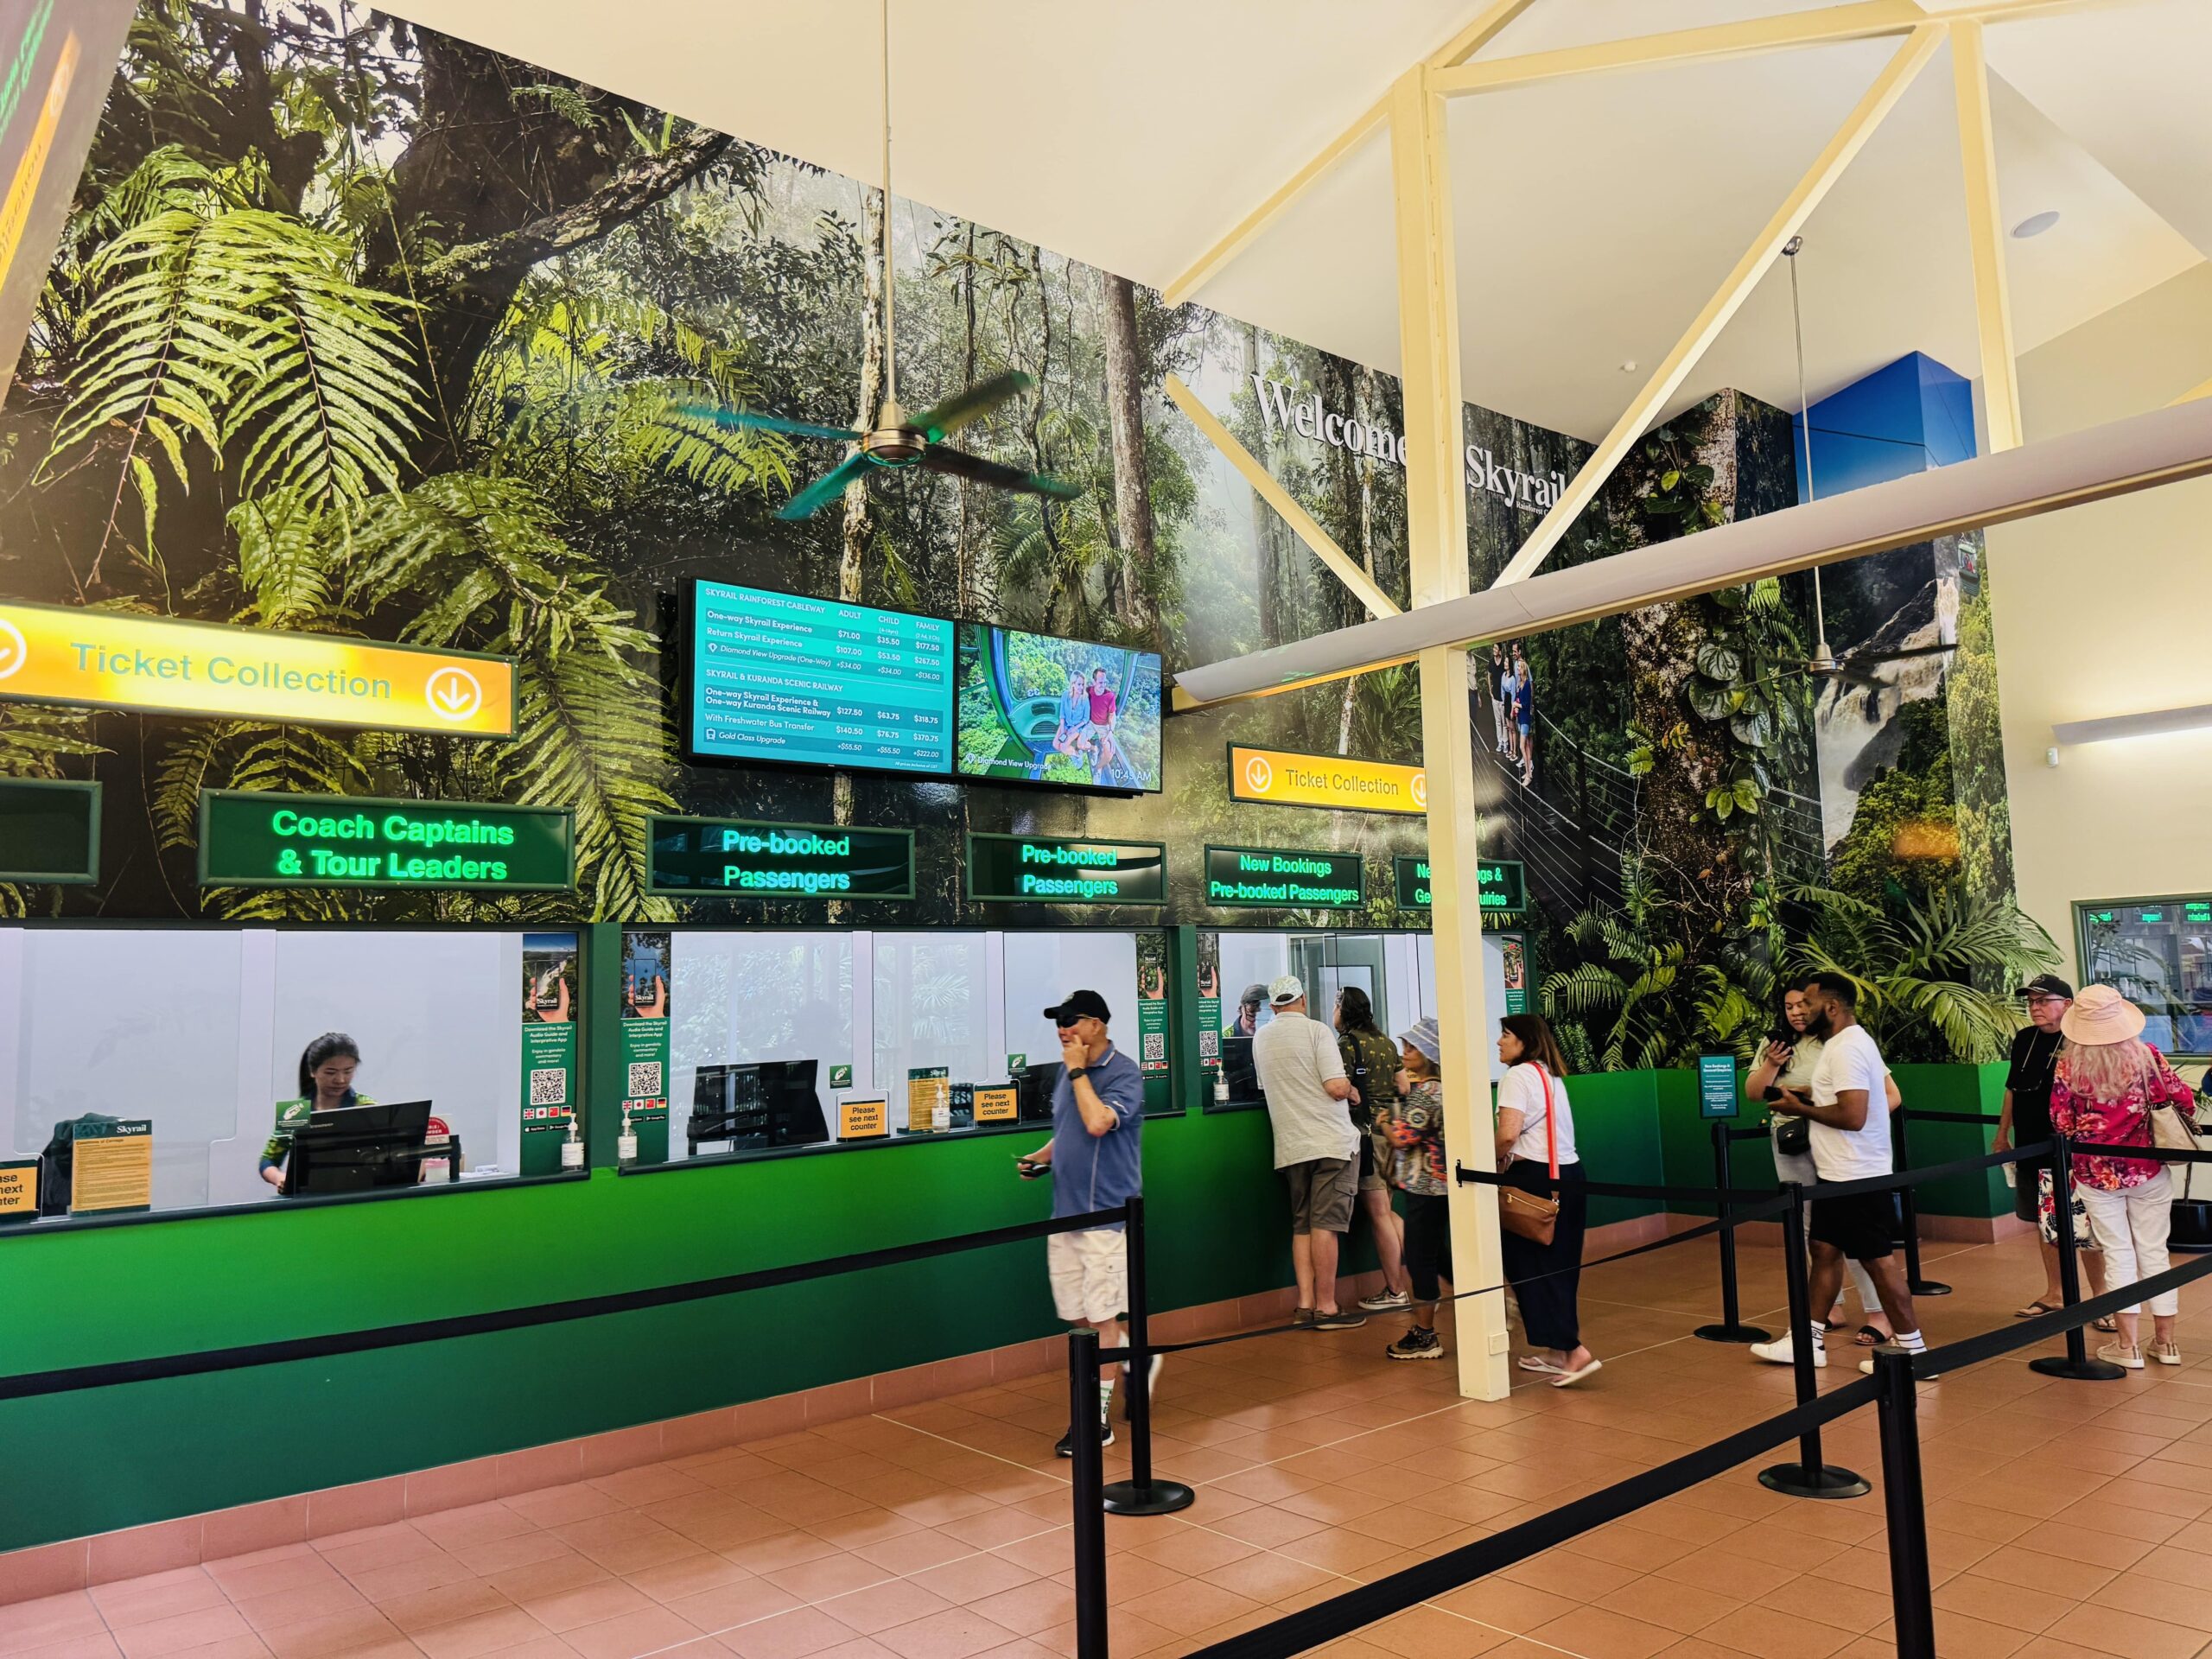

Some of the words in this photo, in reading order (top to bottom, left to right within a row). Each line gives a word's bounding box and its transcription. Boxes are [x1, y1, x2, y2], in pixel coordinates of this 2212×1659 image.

[1249, 373, 1408, 467] Welcome
[1465, 444, 1566, 508] Skyrail
[705, 588, 737, 601] SKYRAIL
[740, 594, 785, 607] RAINFOREST
[786, 601, 825, 613] CABLEWAY
[707, 610, 743, 624] One-way
[744, 616, 771, 627] Skyrail
[772, 620, 812, 633] Experience
[839, 610, 861, 620] ADULT
[878, 615, 899, 625] CHILD
[916, 621, 940, 632] FAMILY
[706, 627, 733, 639] Return
[734, 631, 760, 643] Skyrail
[762, 635, 803, 648] Experience
[837, 629, 861, 640] $71.00
[877, 635, 899, 646] $35.50
[836, 645, 862, 656] $107.00
[916, 641, 940, 652] $177.50
[721, 645, 751, 656] Diamond
[752, 649, 767, 658] View
[769, 652, 797, 662] Upgrade
[798, 655, 831, 668] (One-Way)
[877, 651, 900, 661] $53.50
[914, 656, 940, 666] $267.50
[70, 642, 193, 681] Ticket
[207, 656, 391, 699] Collection
[836, 661, 861, 671] +$34.00
[878, 666, 902, 676] +$34.00
[705, 669, 738, 680] SKYRAIL
[747, 674, 783, 686] KURANDA
[785, 678, 811, 689] SCENIC
[812, 682, 843, 692] RAILWAY
[705, 687, 742, 700] One-way
[743, 691, 770, 702] Skyrail
[771, 695, 811, 707] Experience
[705, 696, 742, 709] One-way
[743, 700, 776, 711] Kuranda
[777, 703, 802, 714] Scenic
[803, 708, 831, 719] Railway
[836, 706, 863, 716] $127.50
[705, 713, 723, 722] With
[724, 715, 767, 728] Freshwater
[784, 722, 815, 732] Transfer
[877, 710, 900, 721] $63.75
[836, 726, 863, 735] $140.50
[877, 729, 899, 739] $76.75
[913, 733, 939, 742] $370.75
[718, 732, 735, 741] Gold
[737, 733, 755, 742] Class
[756, 735, 786, 745] Upgrade
[837, 742, 862, 751] +$55.50
[913, 749, 939, 758] +$222.00
[977, 756, 1007, 766] Diamond
[1007, 759, 1024, 767] View
[1024, 760, 1052, 771] Upgrade
[1136, 771, 1152, 782] AM
[1286, 769, 1328, 789] Ticket
[1332, 773, 1399, 796] Collection
[272, 810, 375, 839] Coach
[384, 816, 514, 848] Captains
[722, 830, 850, 856] Pre-booked
[1022, 843, 1118, 867] Pre-booked
[277, 849, 303, 874] &
[311, 849, 381, 876] Tour
[389, 853, 508, 880] Leaders
[1239, 855, 1269, 872] New
[1273, 855, 1332, 876] Bookings
[1417, 863, 1431, 879] Ne
[1494, 867, 1503, 881] &
[723, 866, 851, 893] Passengers
[1022, 874, 1118, 898] Passengers
[1211, 880, 1287, 899] Pre-booked
[1289, 883, 1359, 905] Passengers
[1478, 891, 1507, 906] uiries
[117, 1124, 147, 1134] Skyrail
[850, 1122, 877, 1131] counter
